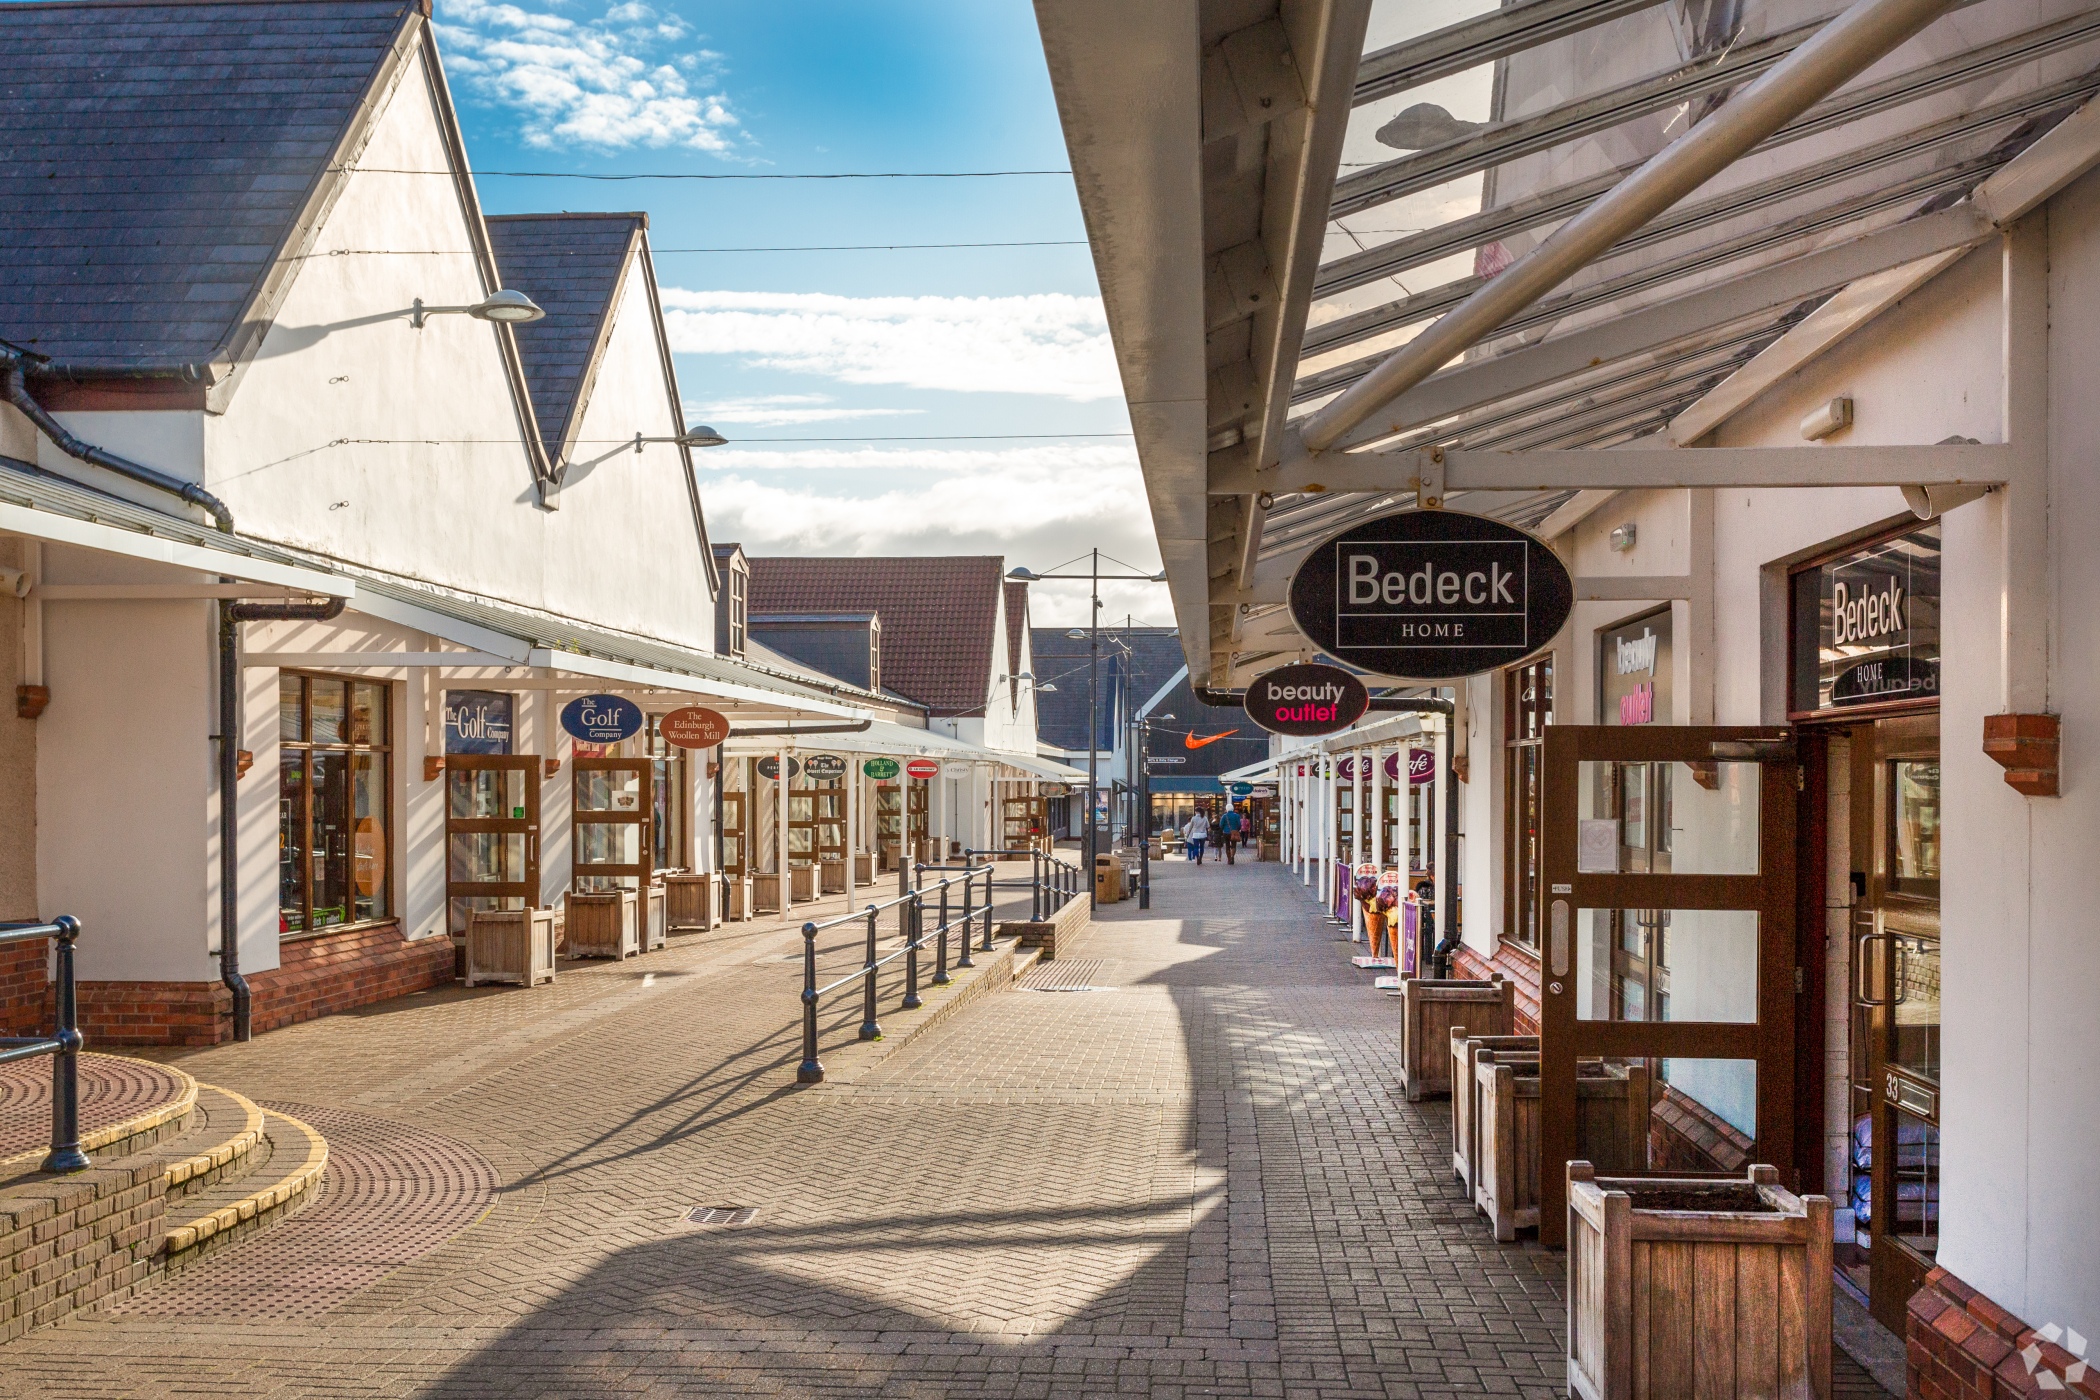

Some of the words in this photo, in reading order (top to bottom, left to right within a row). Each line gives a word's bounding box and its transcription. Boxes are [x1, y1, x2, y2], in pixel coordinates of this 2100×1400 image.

[1349, 555, 1515, 605] Bedeck
[1835, 575, 1904, 644] Bedeck
[1401, 623, 1464, 637] HOME
[1617, 627, 1657, 677] beauty
[1857, 662, 1882, 683] HOME
[581, 698, 595, 706] The
[1267, 682, 1345, 704] beauty
[1275, 703, 1338, 722] outlet
[1620, 681, 1652, 726] outlet
[445, 706, 457, 721] The
[457, 705, 488, 739] Golf
[581, 708, 623, 726] Golf
[687, 711, 702, 721] The
[486, 726, 510, 743] Company
[589, 730, 622, 740] Company
[674, 720, 715, 732] Edinburgh
[668, 731, 700, 740] Woollen
[703, 731, 720, 740] Mill
[1886, 1072, 1898, 1101] 33
